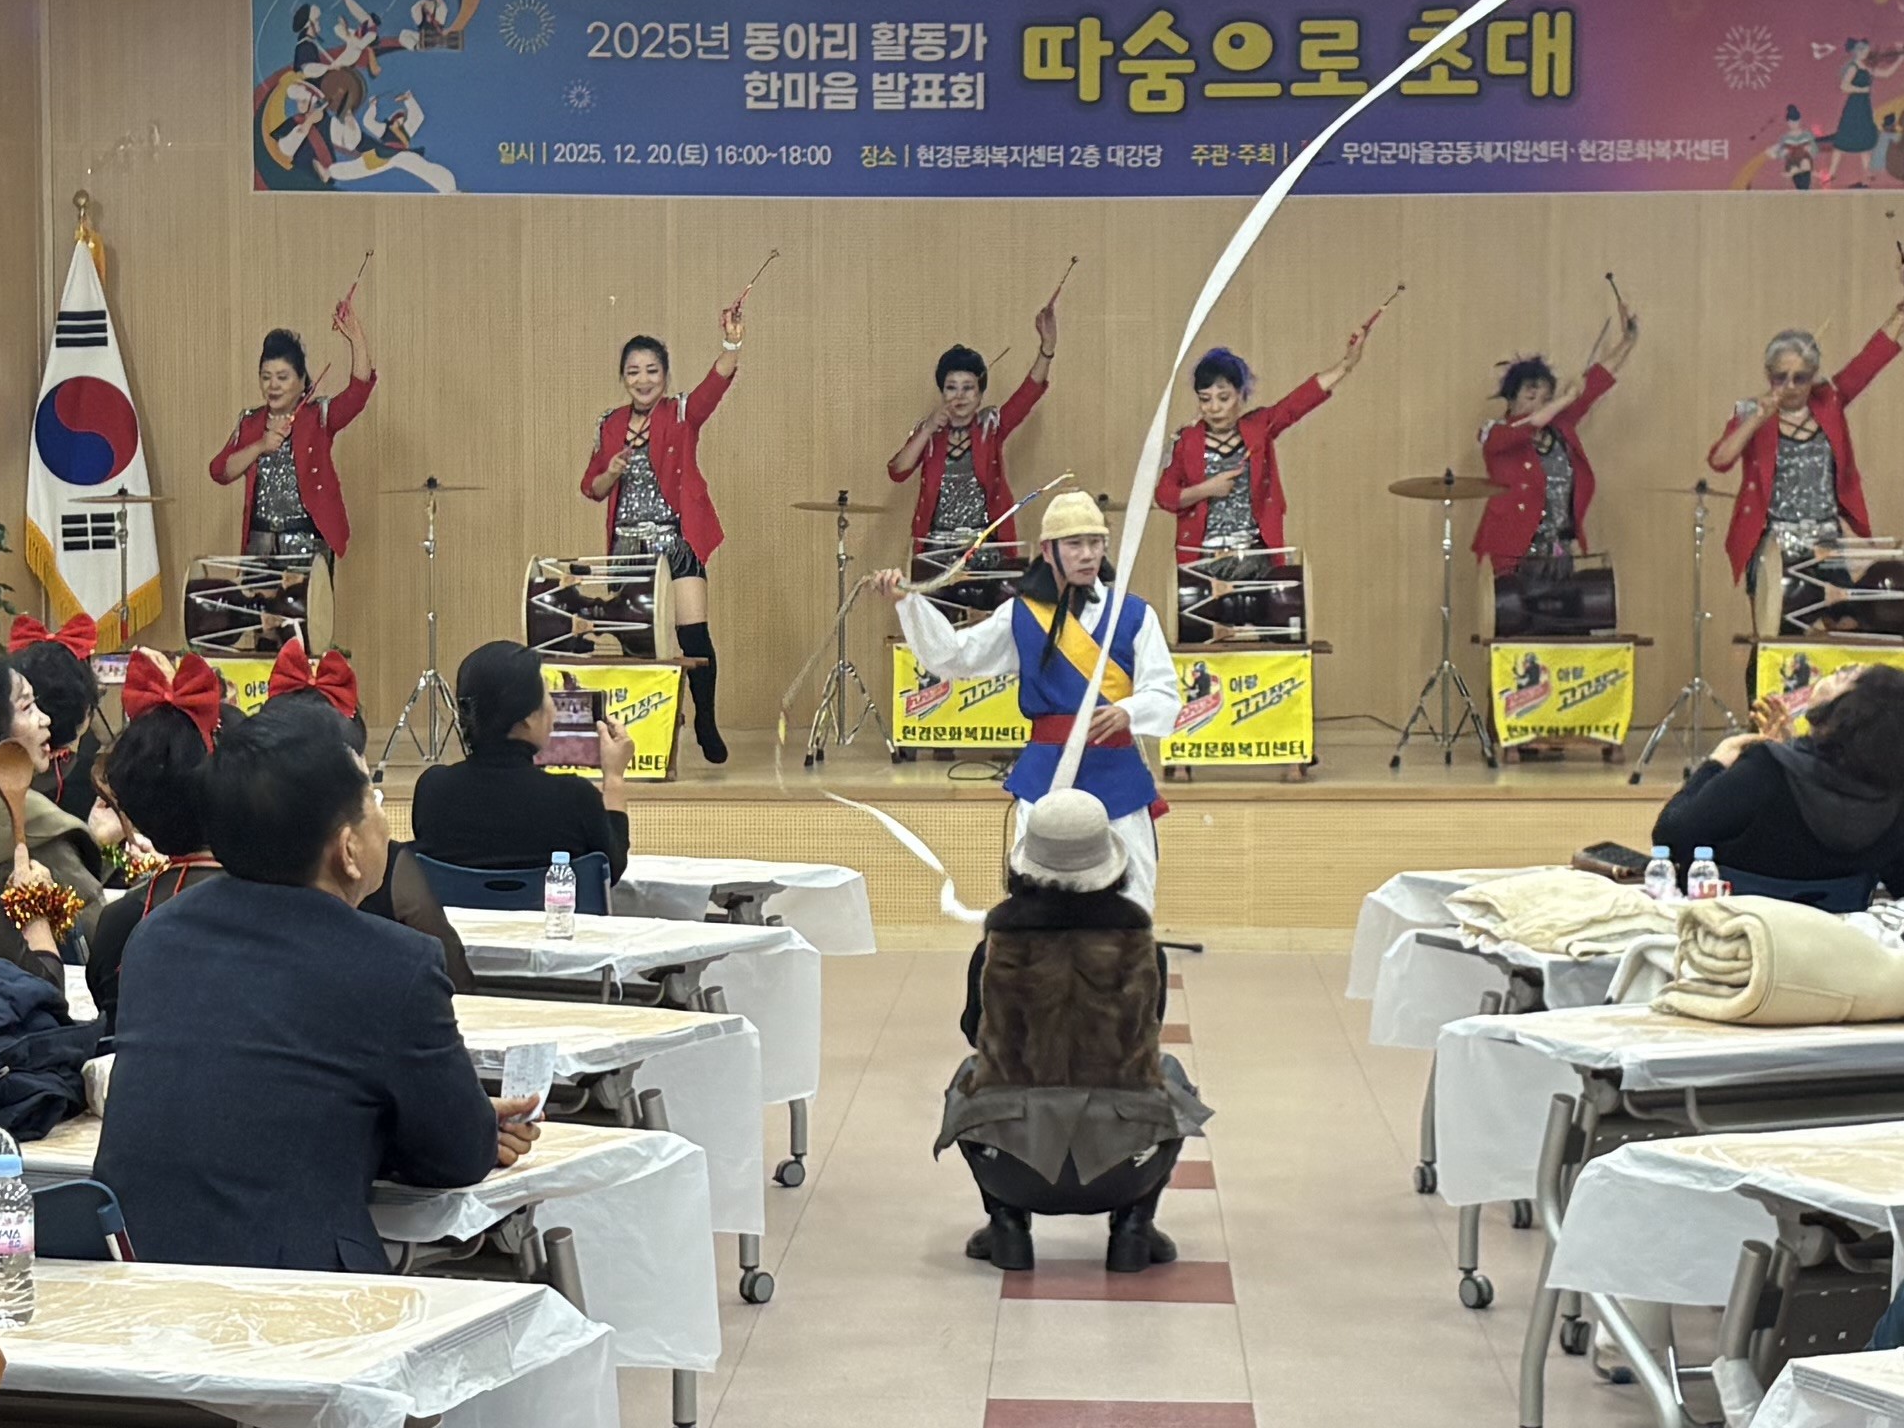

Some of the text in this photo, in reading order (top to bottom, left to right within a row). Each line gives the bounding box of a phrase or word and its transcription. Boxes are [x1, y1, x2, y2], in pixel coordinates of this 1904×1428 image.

[586, 21, 988, 61] 2025년 동아리 활동가
[1023, 8, 1572, 113] 따숨으로 초대
[743, 71, 985, 110] 한마음 발표회
[498, 142, 534, 165] 일시
[553, 142, 606, 163] 2025.
[614, 144, 642, 163] 12.
[715, 144, 832, 166] 16:00~18:00
[860, 146, 897, 168] 장소
[916, 145, 1064, 168] 현경문화복지센터
[1070, 145, 1101, 167] 2층
[1106, 144, 1163, 168] 대강당
[902, 725, 1025, 741] 현경문화복지센터
[1170, 740, 1304, 757] 현경문화복지센터
